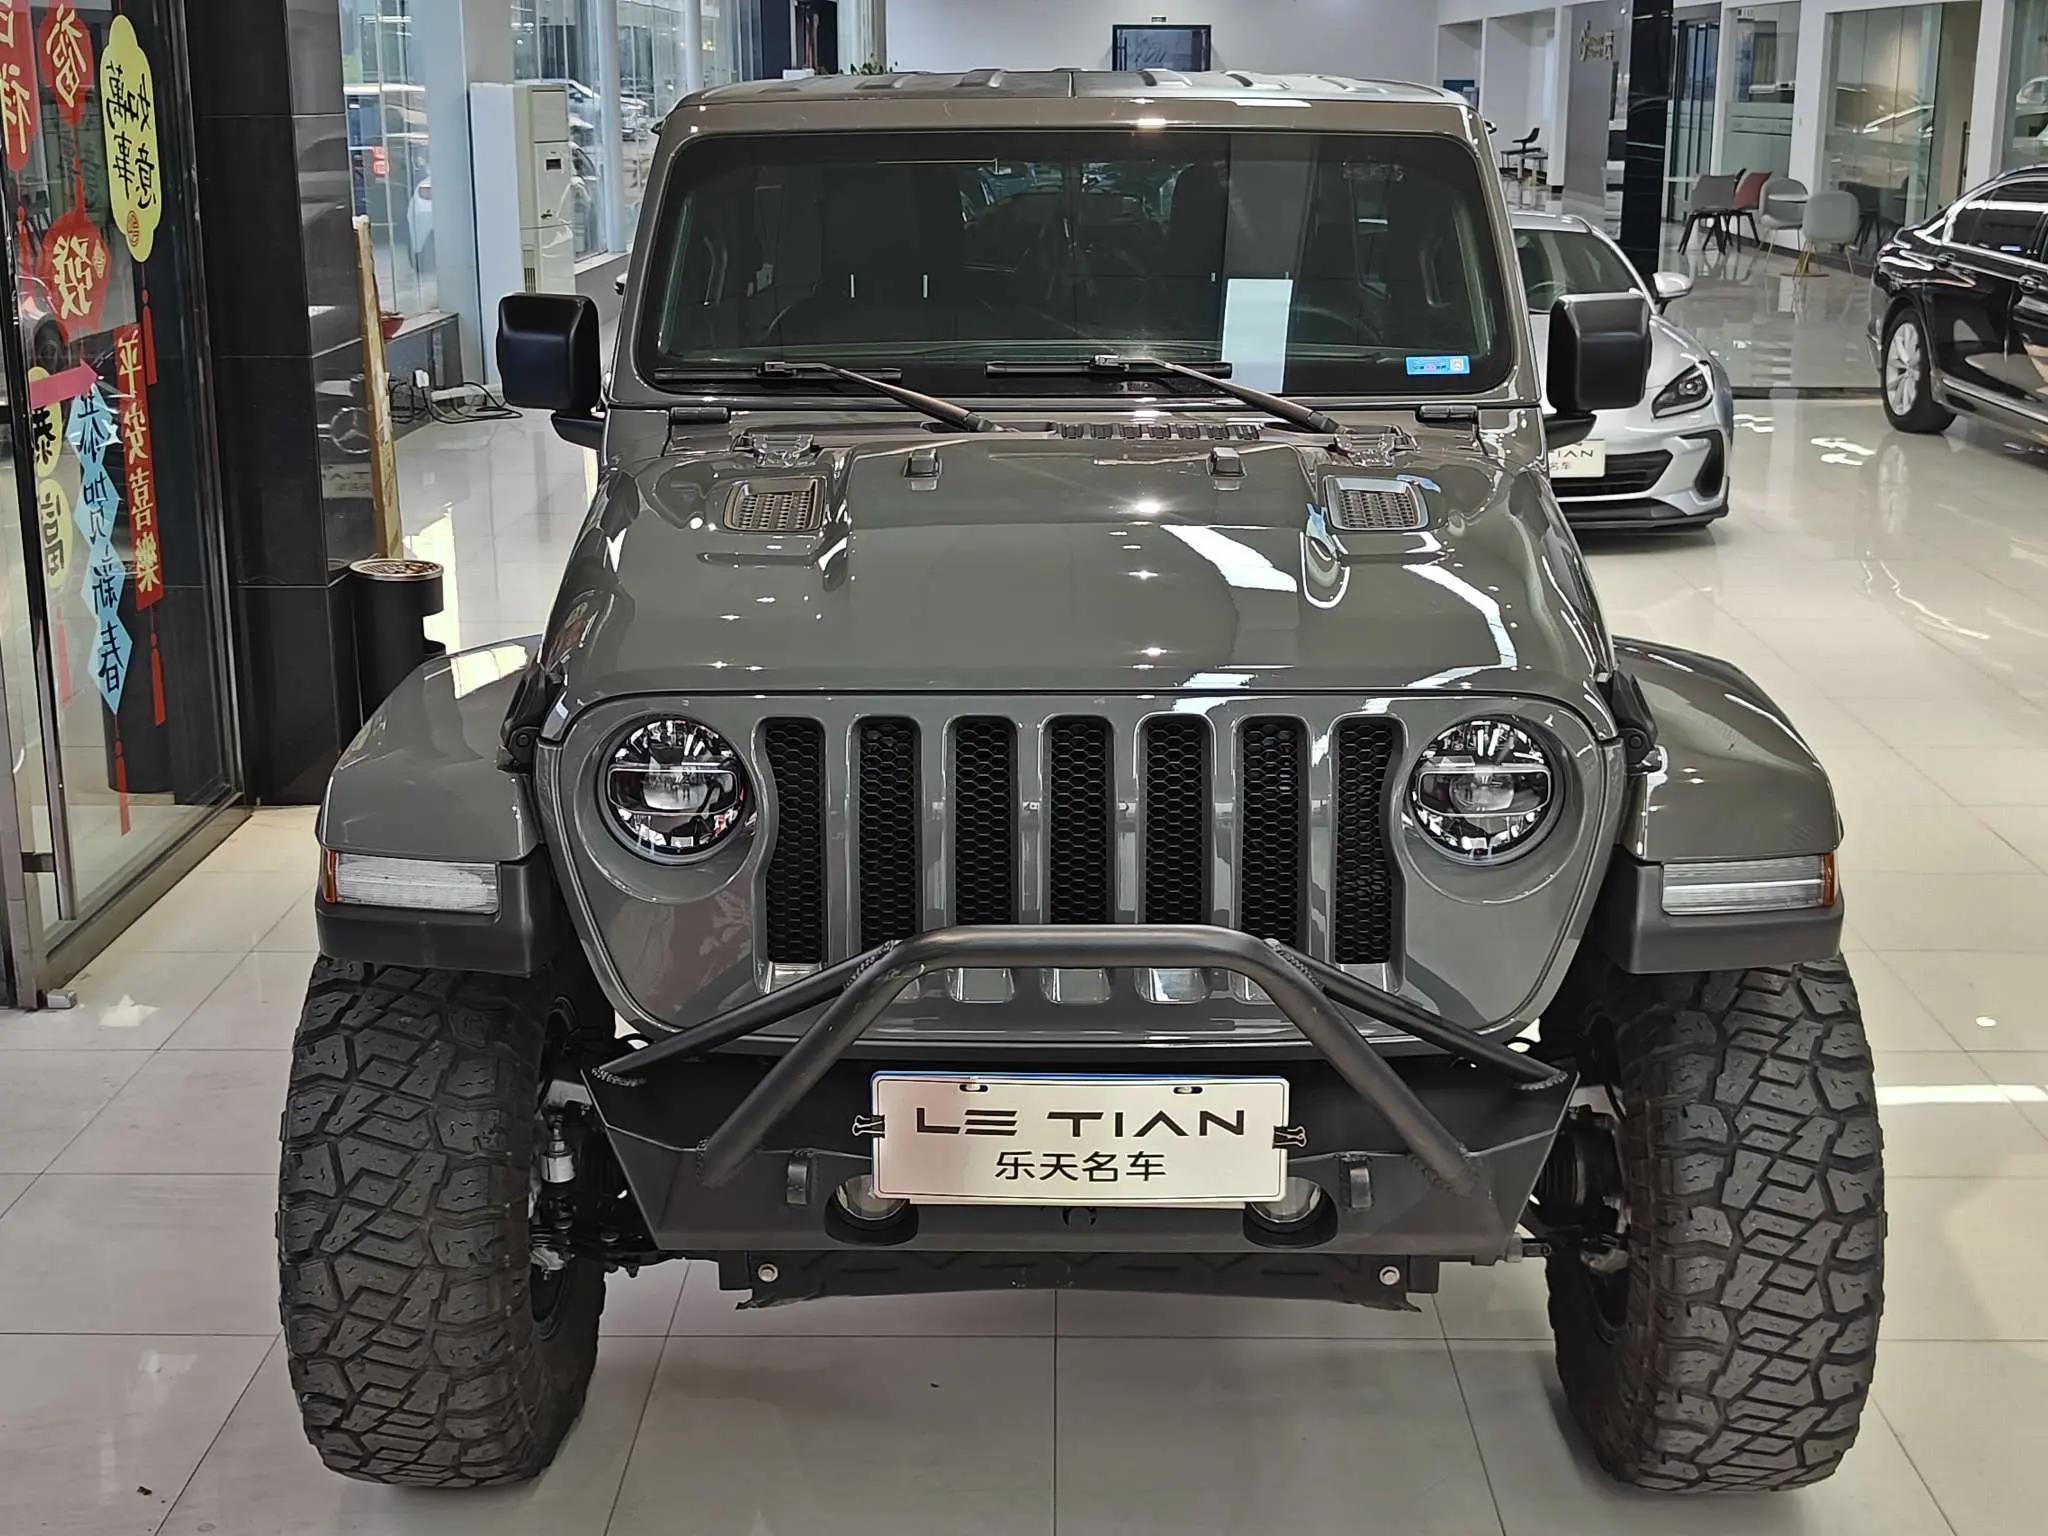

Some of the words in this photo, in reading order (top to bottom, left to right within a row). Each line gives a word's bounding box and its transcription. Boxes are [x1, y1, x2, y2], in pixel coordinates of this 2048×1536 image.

[916, 1106, 1018, 1136] LE
[1046, 1109, 1245, 1138] TIAN
[995, 1150, 1167, 1183] 乐天名车
